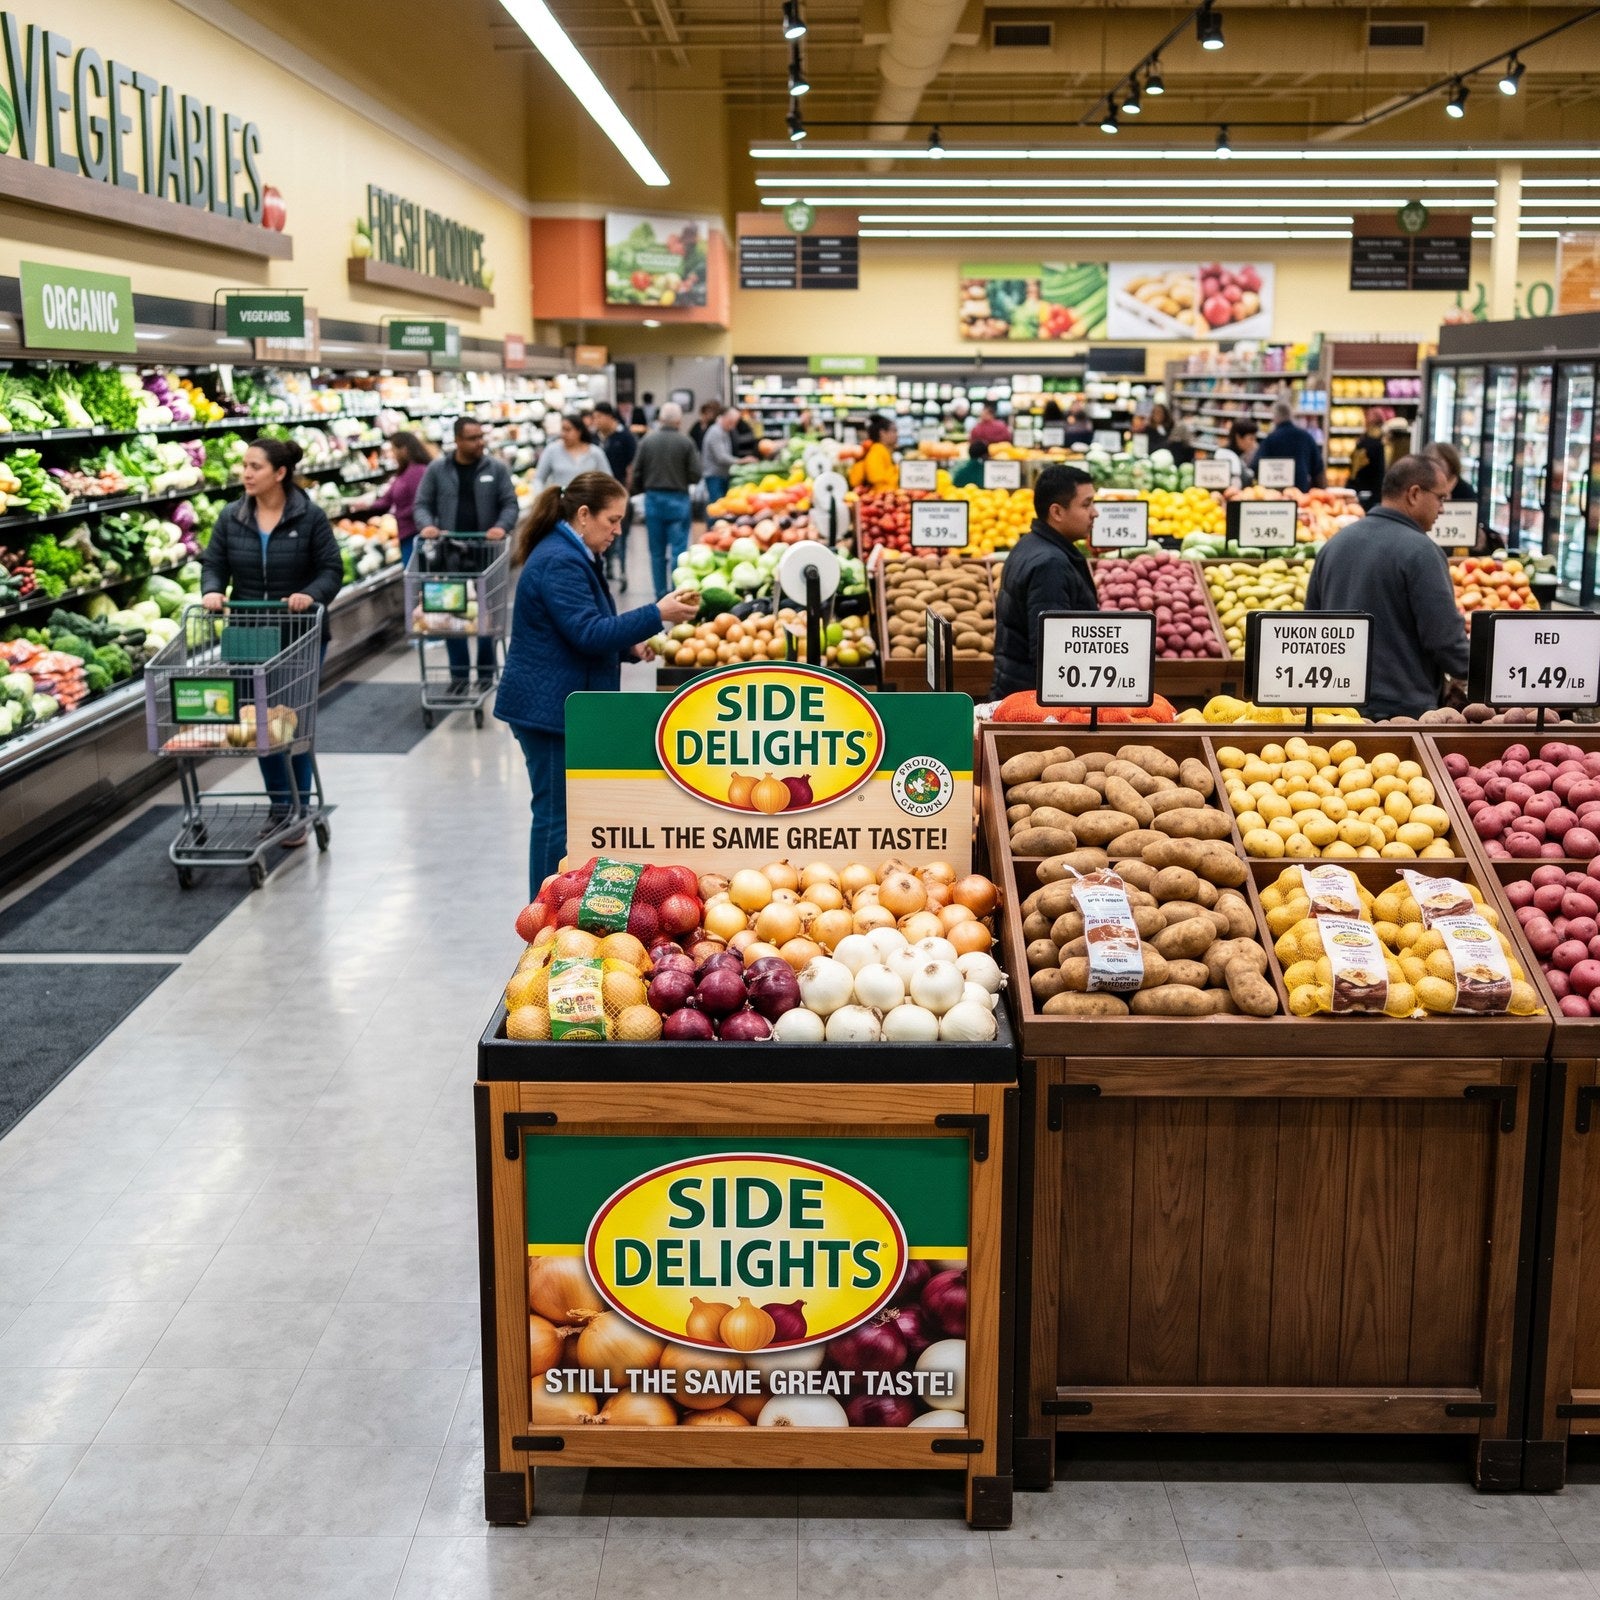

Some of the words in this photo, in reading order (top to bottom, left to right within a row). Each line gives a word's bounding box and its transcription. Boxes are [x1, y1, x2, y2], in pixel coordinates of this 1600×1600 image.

[0, 11, 264, 225] VEGETABLES
[367, 184, 420, 274] FRESH
[42, 283, 119, 334] ORGANIC
[1072, 626, 1121, 638] RUSSET
[1274, 626, 1317, 639] YUKON
[1321, 626, 1355, 639] GOLD
[1534, 632, 1560, 645] RED
[1064, 641, 1129, 654] POTATOES
[1281, 642, 1346, 654] POTATOES
[716, 684, 825, 722] SIDE
[899, 758, 947, 777] PROUDLY
[900, 798, 943, 814] GROWN
[591, 826, 654, 849] STILL
[661, 827, 705, 849] THE
[713, 826, 778, 849] SAME
[786, 827, 861, 849] GREAT
[868, 827, 948, 850] TASTE!
[667, 1177, 825, 1230] SIDE
[546, 1368, 617, 1395] STILL
[626, 1369, 677, 1395] THE
[684, 1369, 762, 1395] SAME
[769, 1370, 855, 1396] GREAT
[863, 1371, 954, 1397] TASTE!
